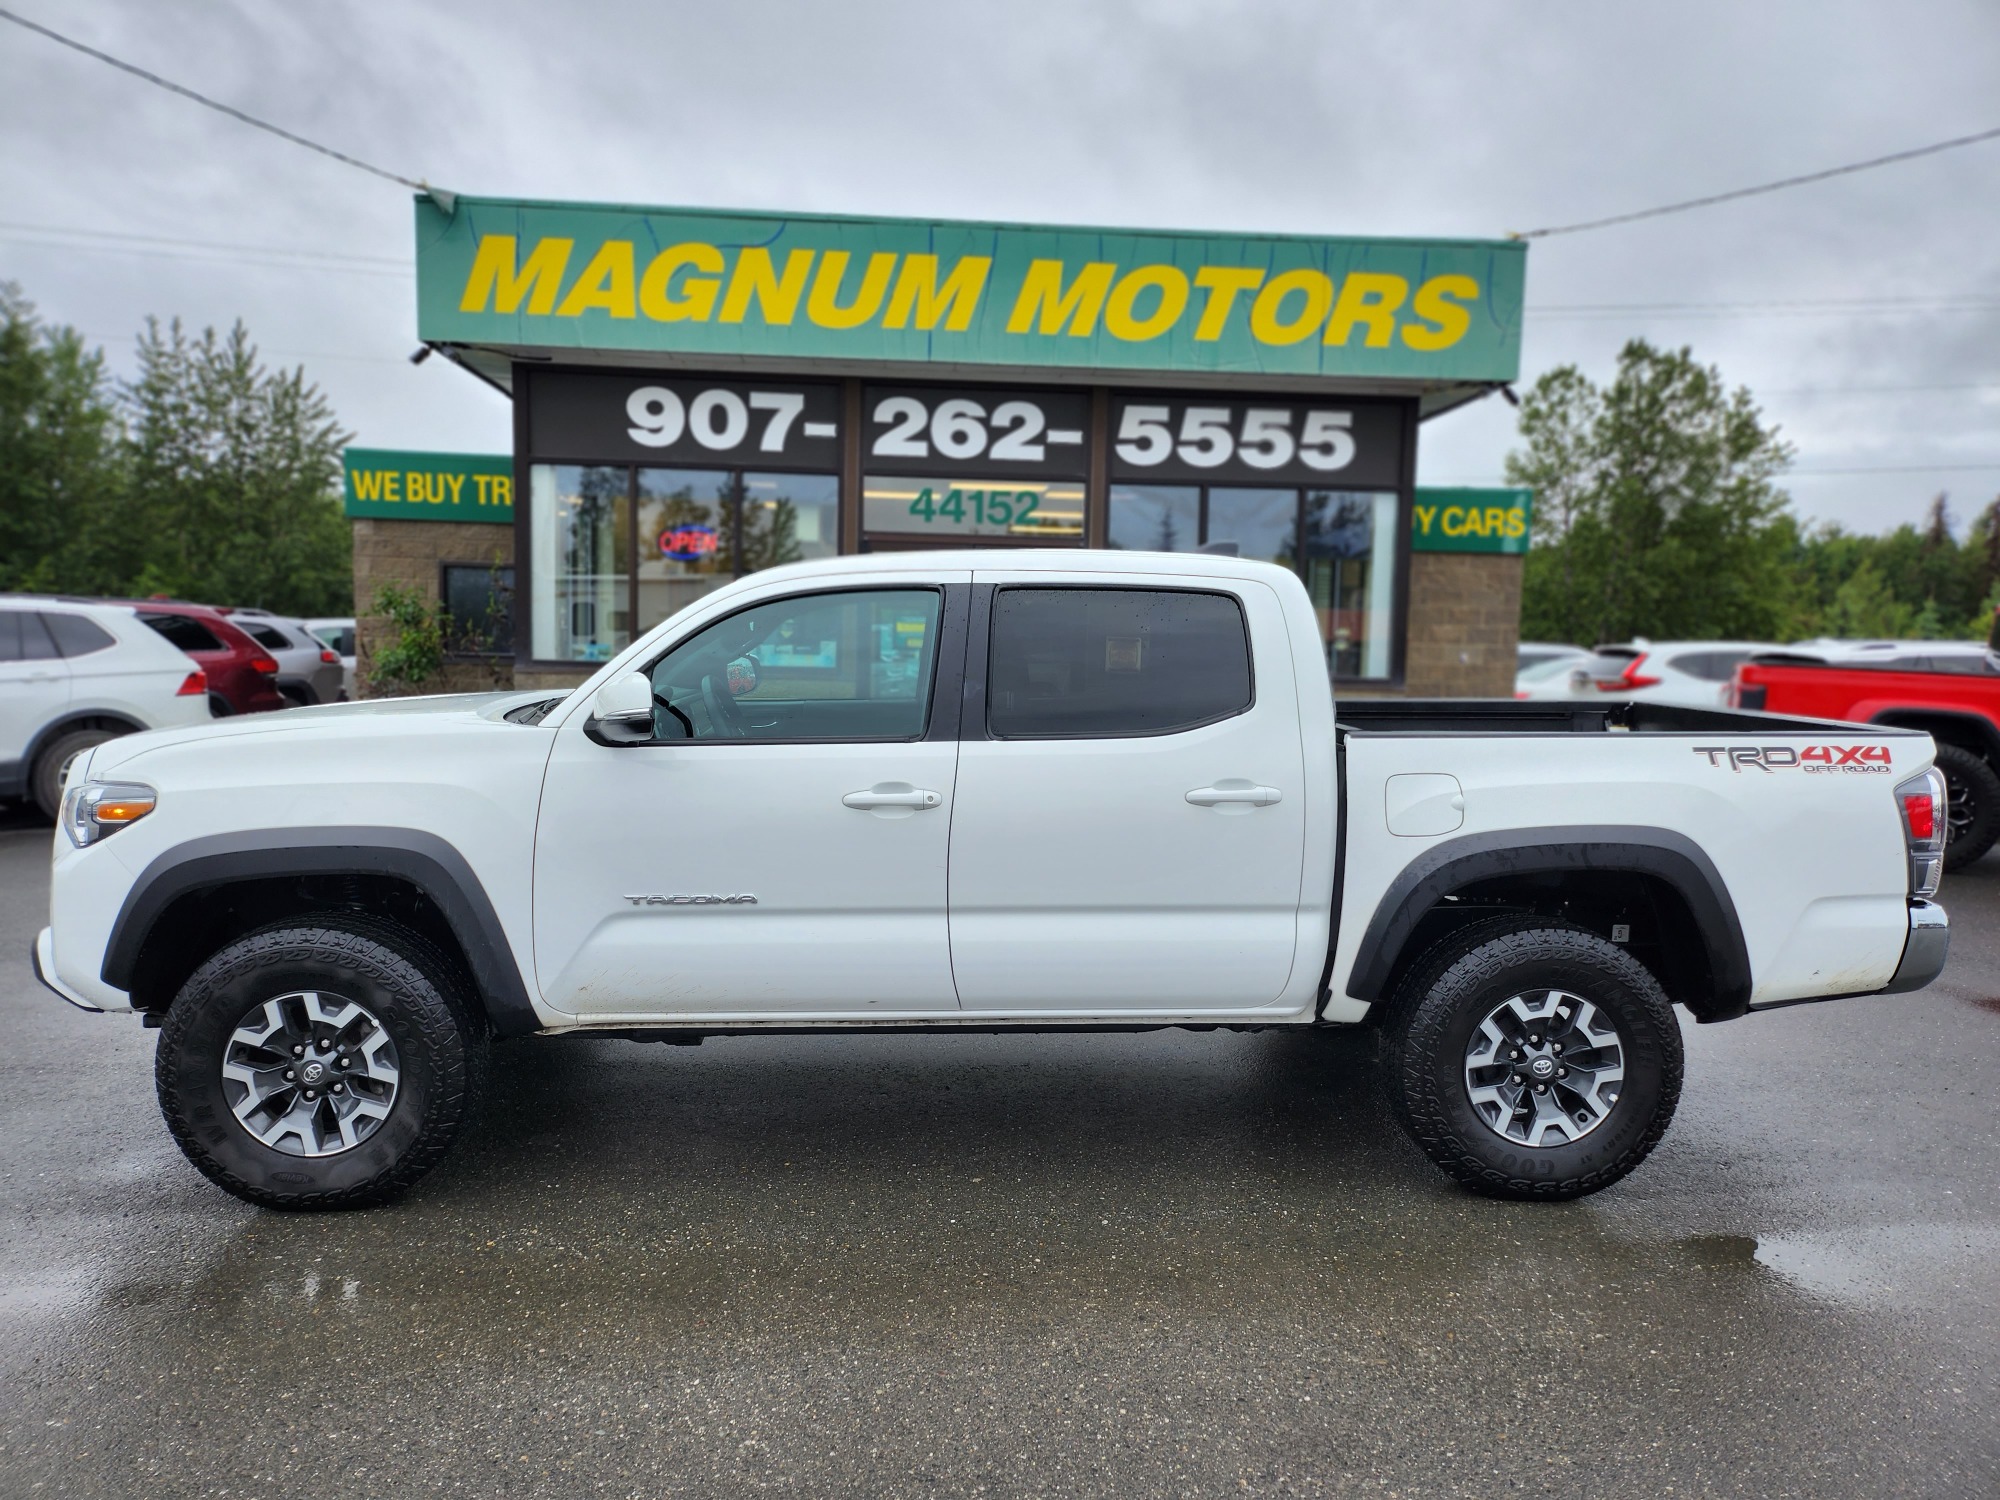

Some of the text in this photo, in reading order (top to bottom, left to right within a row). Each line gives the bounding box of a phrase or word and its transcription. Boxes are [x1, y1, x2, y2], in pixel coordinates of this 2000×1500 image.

[460, 235, 1479, 351] MAGNUM MOTORS
[626, 386, 1355, 470] 907- 262- 5555
[352, 470, 514, 506] WE BUY TR
[909, 487, 1040, 525] 44152
[1411, 505, 1525, 538] Y CARS
[658, 531, 718, 553] OPEN
[1692, 746, 1800, 774] TRD
[1803, 765, 1892, 774] OFF ROAD
[624, 894, 758, 905] TACOMA
